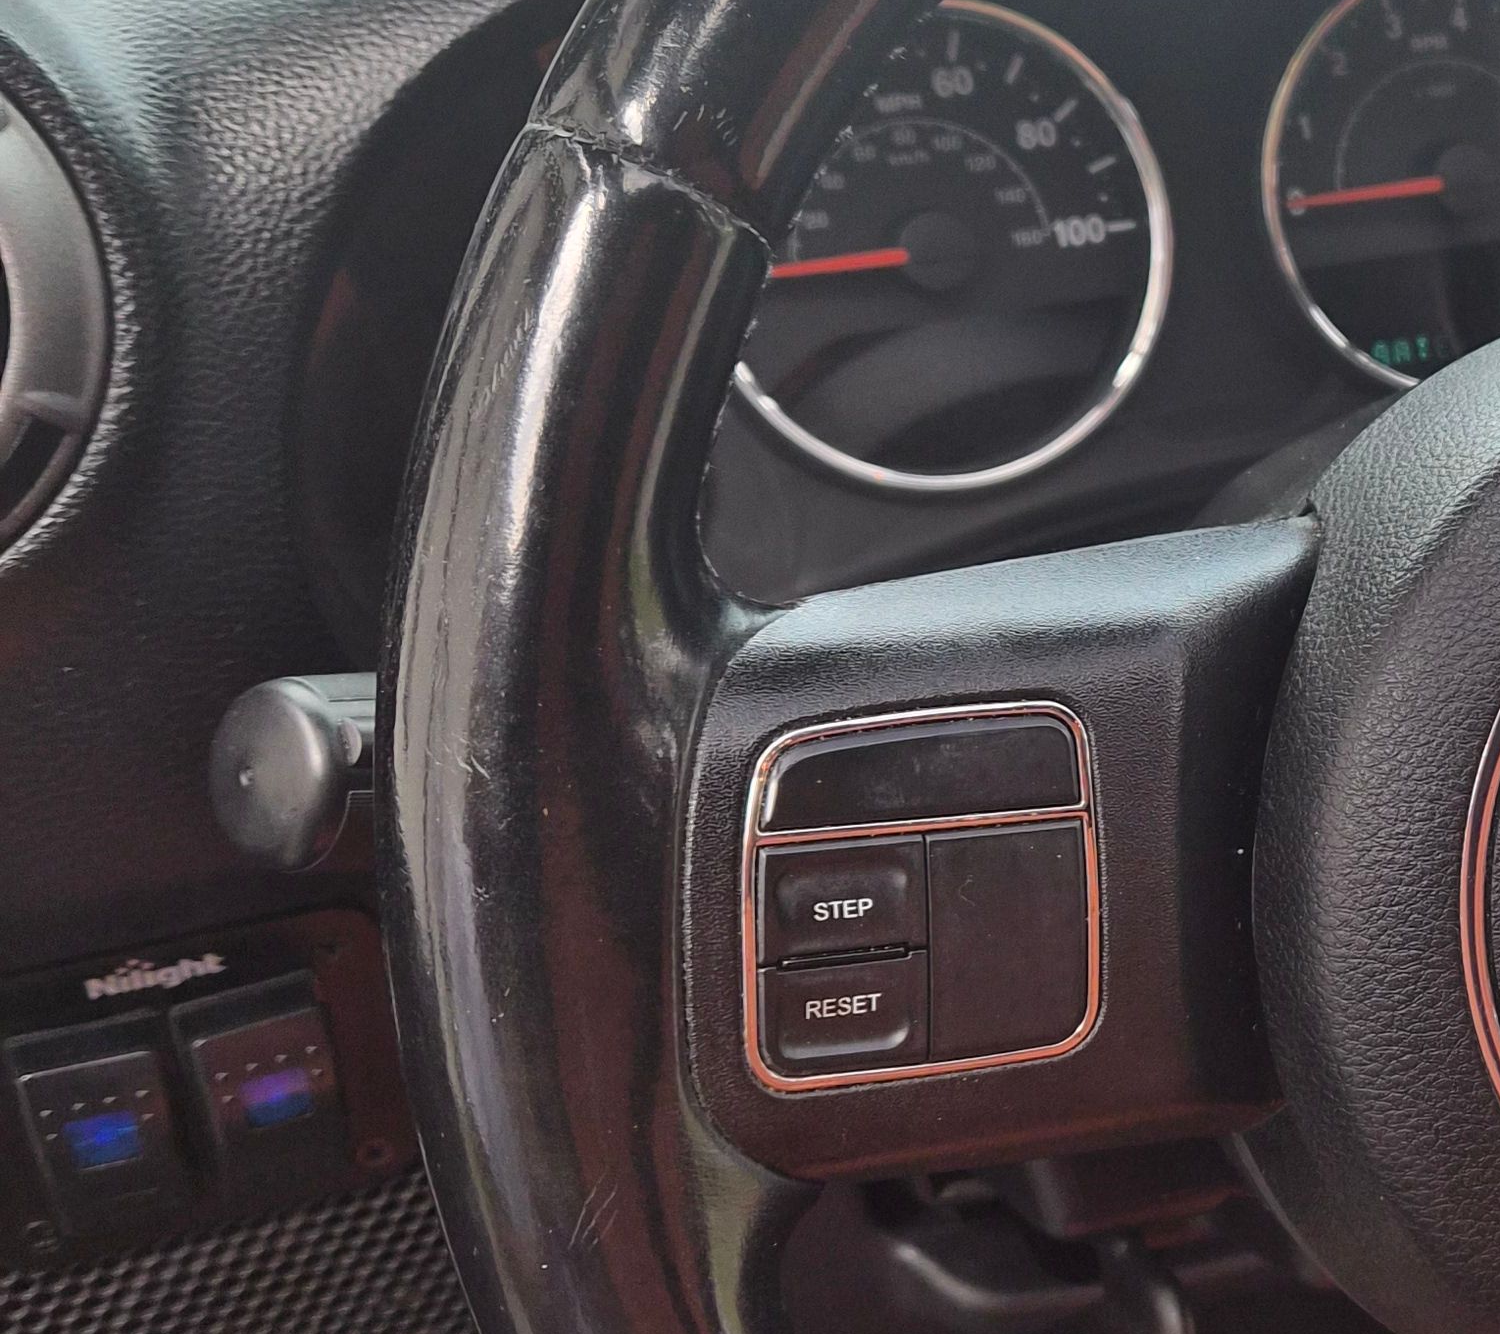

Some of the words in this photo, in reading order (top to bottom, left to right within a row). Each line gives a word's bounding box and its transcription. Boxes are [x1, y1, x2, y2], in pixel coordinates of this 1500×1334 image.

[931, 66, 974, 98] 60
[1015, 120, 1057, 150] 80
[1054, 216, 1106, 248] 100
[813, 897, 874, 923] STEP
[804, 993, 882, 1020] RESET
